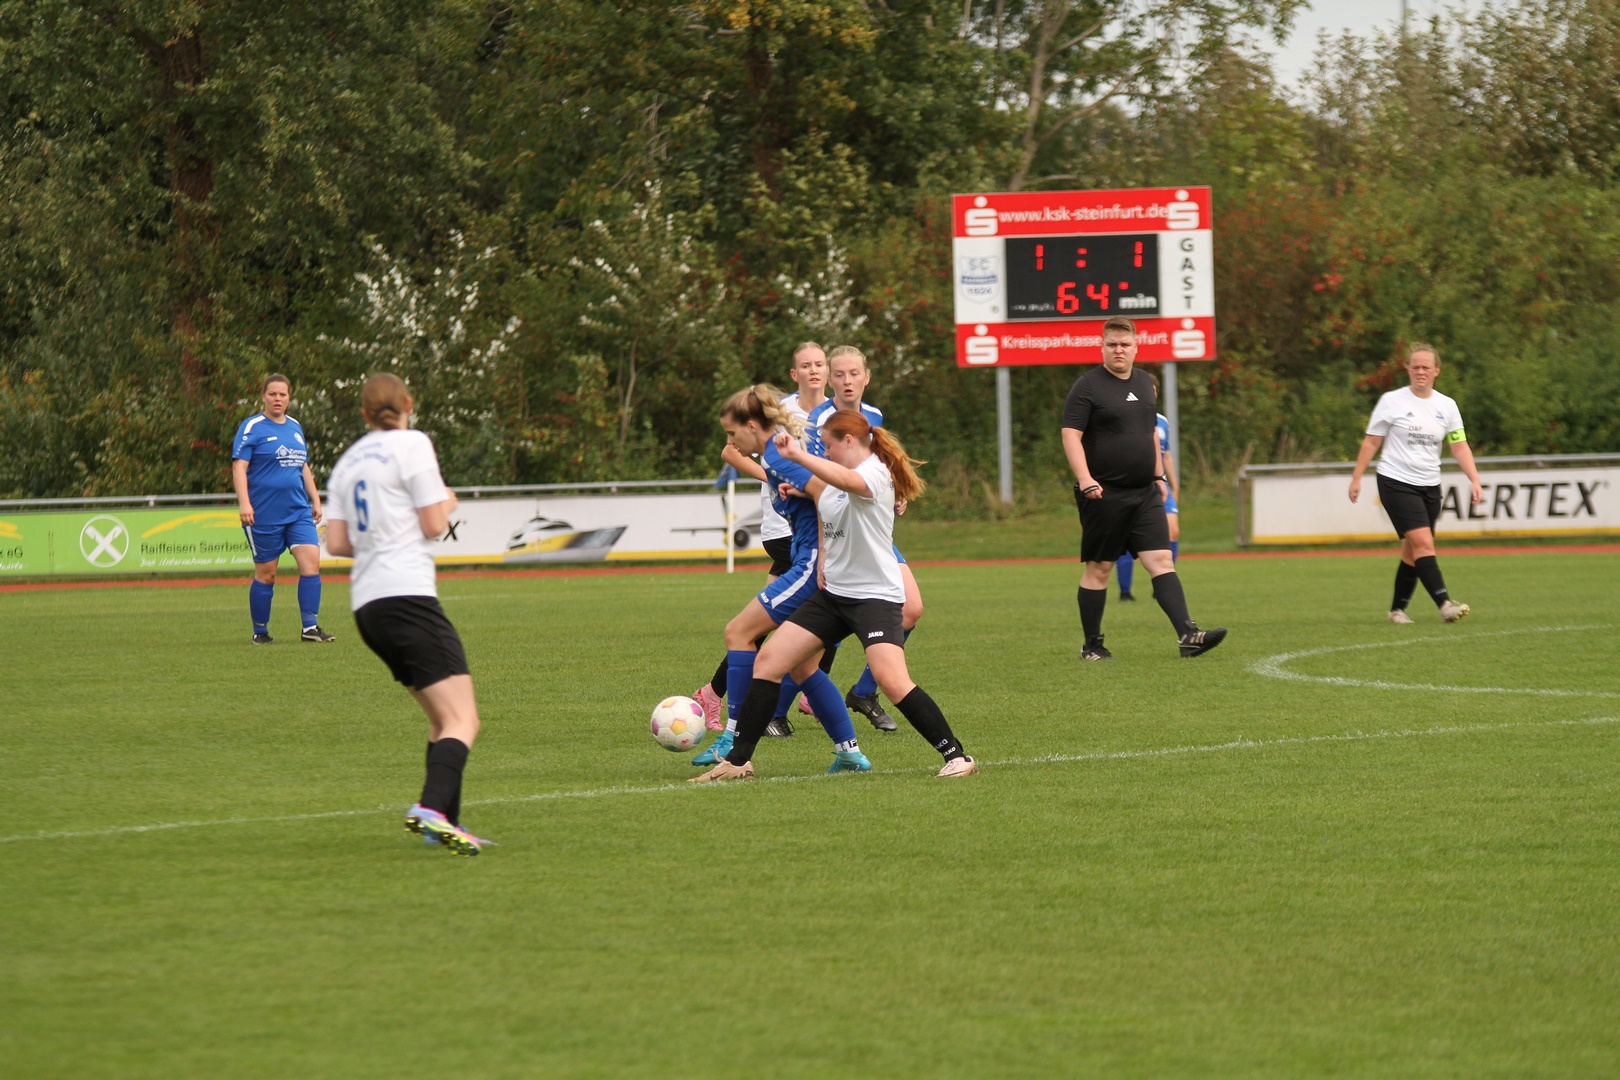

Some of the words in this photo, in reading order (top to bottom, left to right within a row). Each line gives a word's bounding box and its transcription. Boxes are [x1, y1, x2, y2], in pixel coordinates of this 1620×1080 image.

[1000, 204, 1168, 223] www.ksk-steinfurt.de
[1035, 244, 1044, 271] 1
[1133, 241, 1144, 268] 1
[1118, 293, 1157, 309] min
[1001, 333, 1102, 350] Kreissparkasse
[1450, 431, 1460, 441] C
[353, 479, 370, 532] 6
[1440, 480, 1600, 520] AERTEX
[141, 542, 196, 555] Raiffeisen
[867, 630, 884, 639] JAKO
[935, 738, 949, 749] AKO
